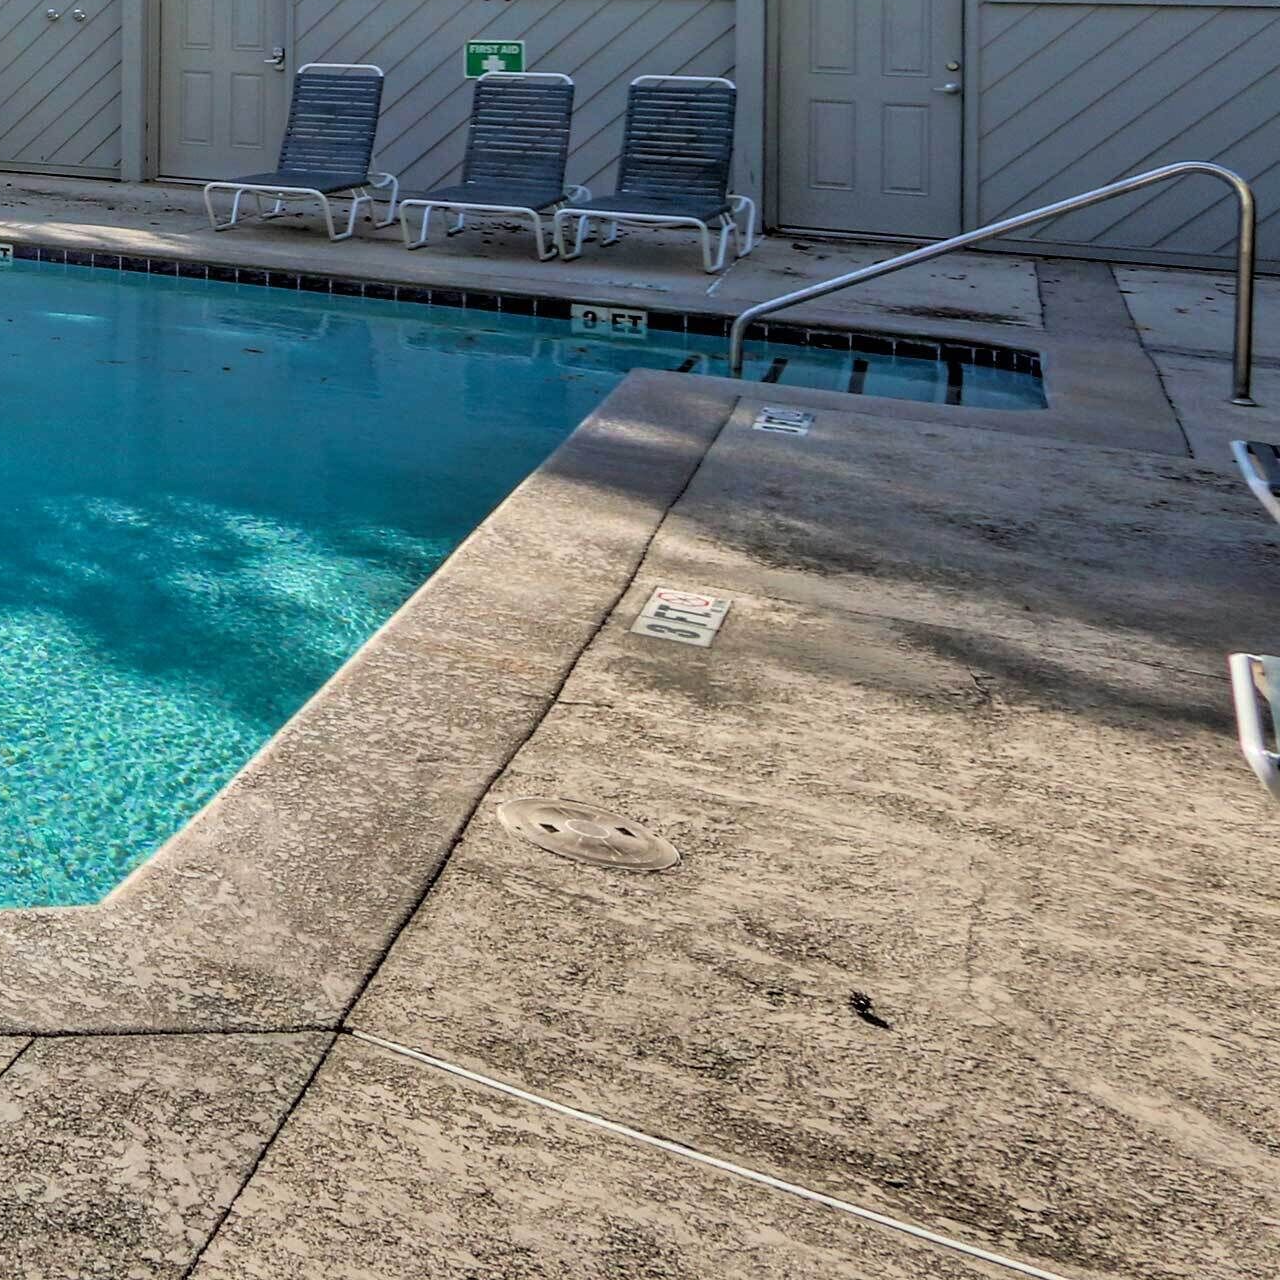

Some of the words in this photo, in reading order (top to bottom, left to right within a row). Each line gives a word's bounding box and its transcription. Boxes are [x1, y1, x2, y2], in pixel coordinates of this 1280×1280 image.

[469, 45, 499, 54] FIRST
[501, 45, 520, 55] AID
[646, 623, 702, 639] 3
